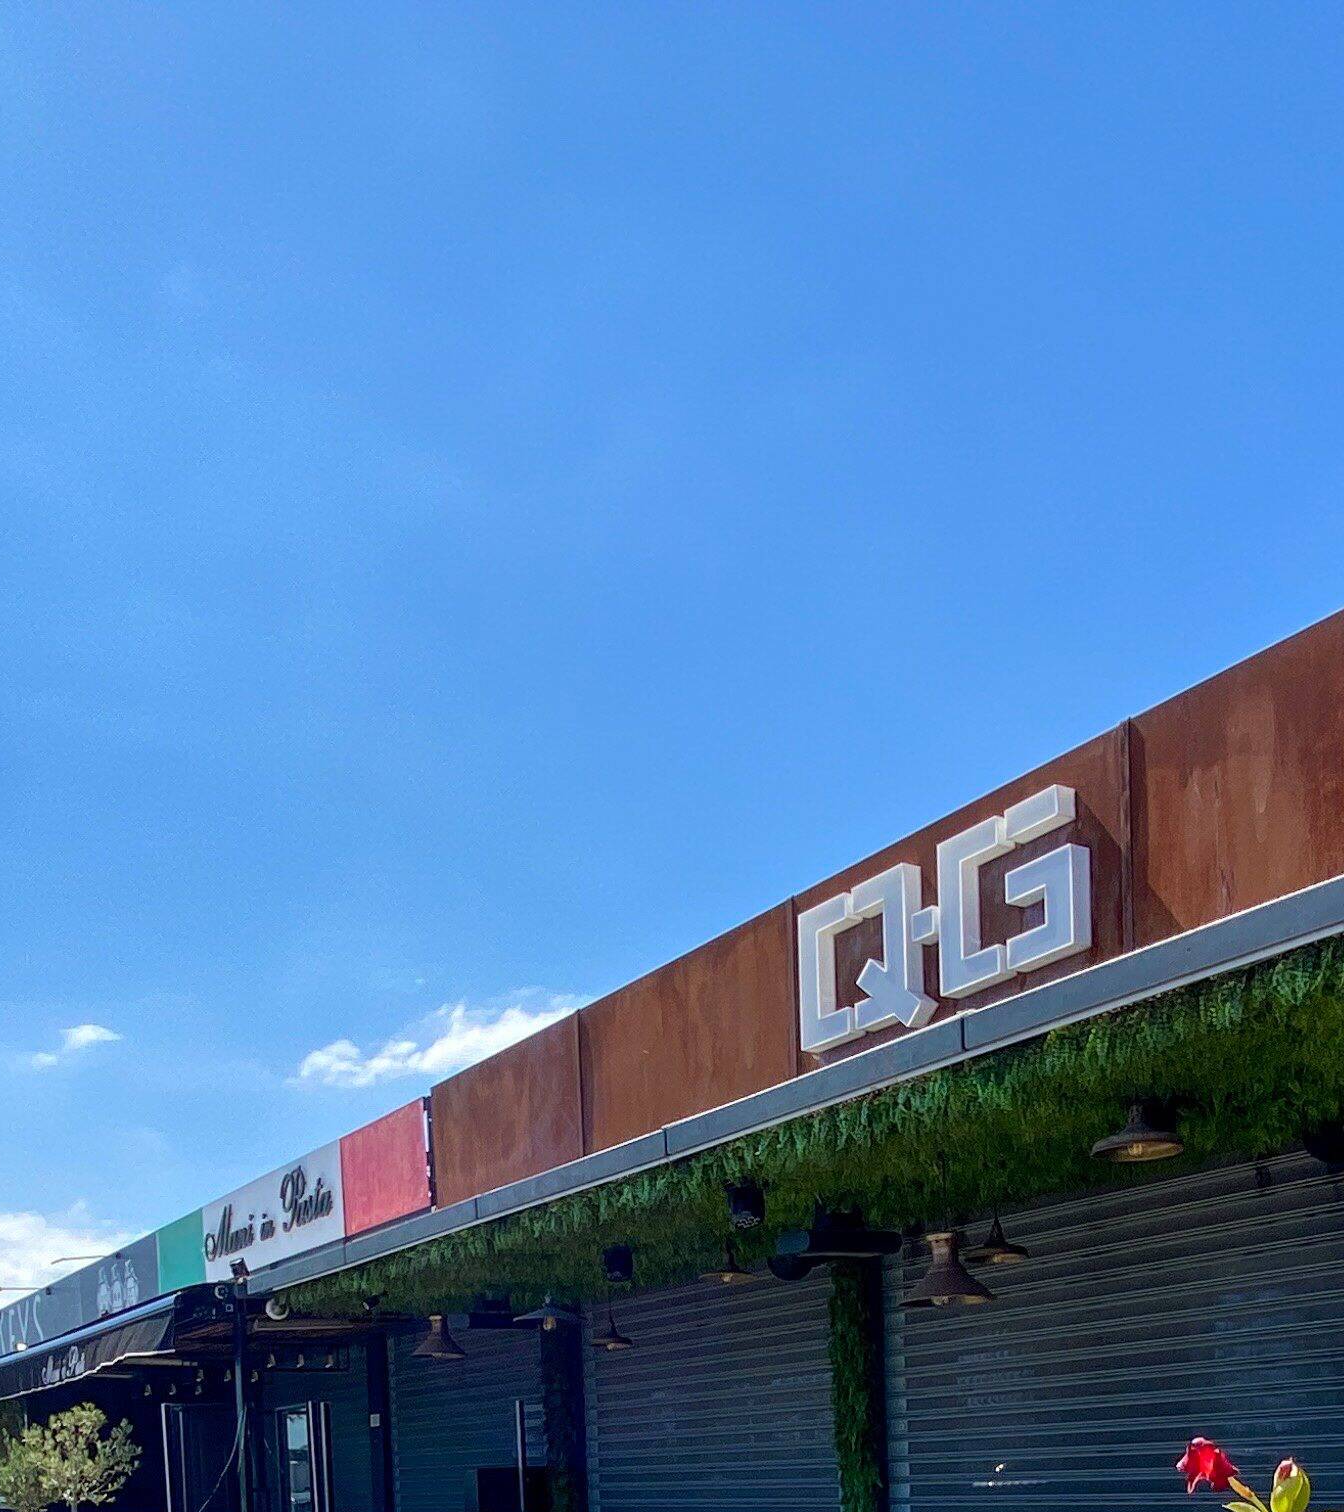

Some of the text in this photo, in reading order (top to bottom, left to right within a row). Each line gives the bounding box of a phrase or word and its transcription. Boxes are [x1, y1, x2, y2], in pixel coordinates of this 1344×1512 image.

[204, 1164, 334, 1262] Mani in Pasta
